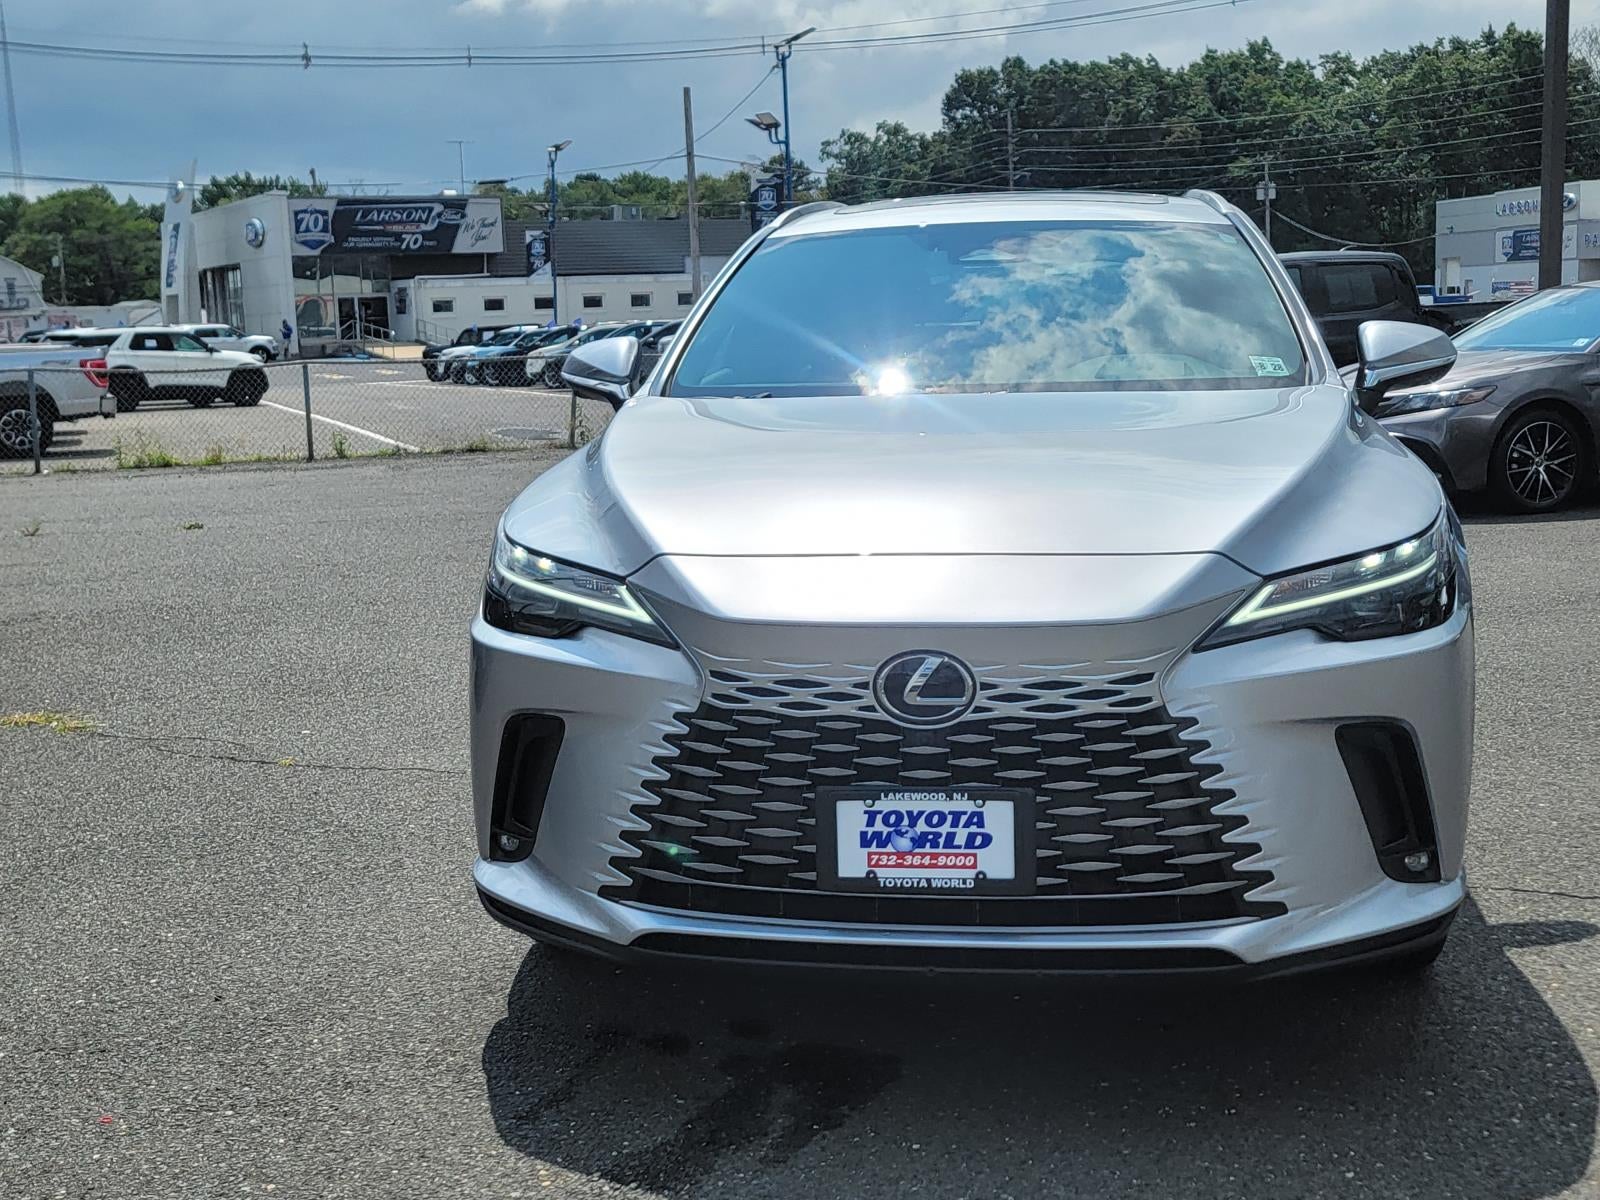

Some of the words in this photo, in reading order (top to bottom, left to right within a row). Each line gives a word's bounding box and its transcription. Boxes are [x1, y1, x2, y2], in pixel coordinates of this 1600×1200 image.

[1496, 199, 1539, 216] LARSON
[354, 208, 430, 222] LARSON
[297, 213, 323, 232] 70
[401, 234, 423, 249] 70
[880, 792, 950, 802] LAKEWOOD,
[953, 792, 968, 801] NJ
[863, 809, 986, 829] TOYOTA
[870, 854, 975, 867] 732-364-9000
[878, 878, 928, 888] TOYOTA
[931, 878, 975, 889] WORLD
